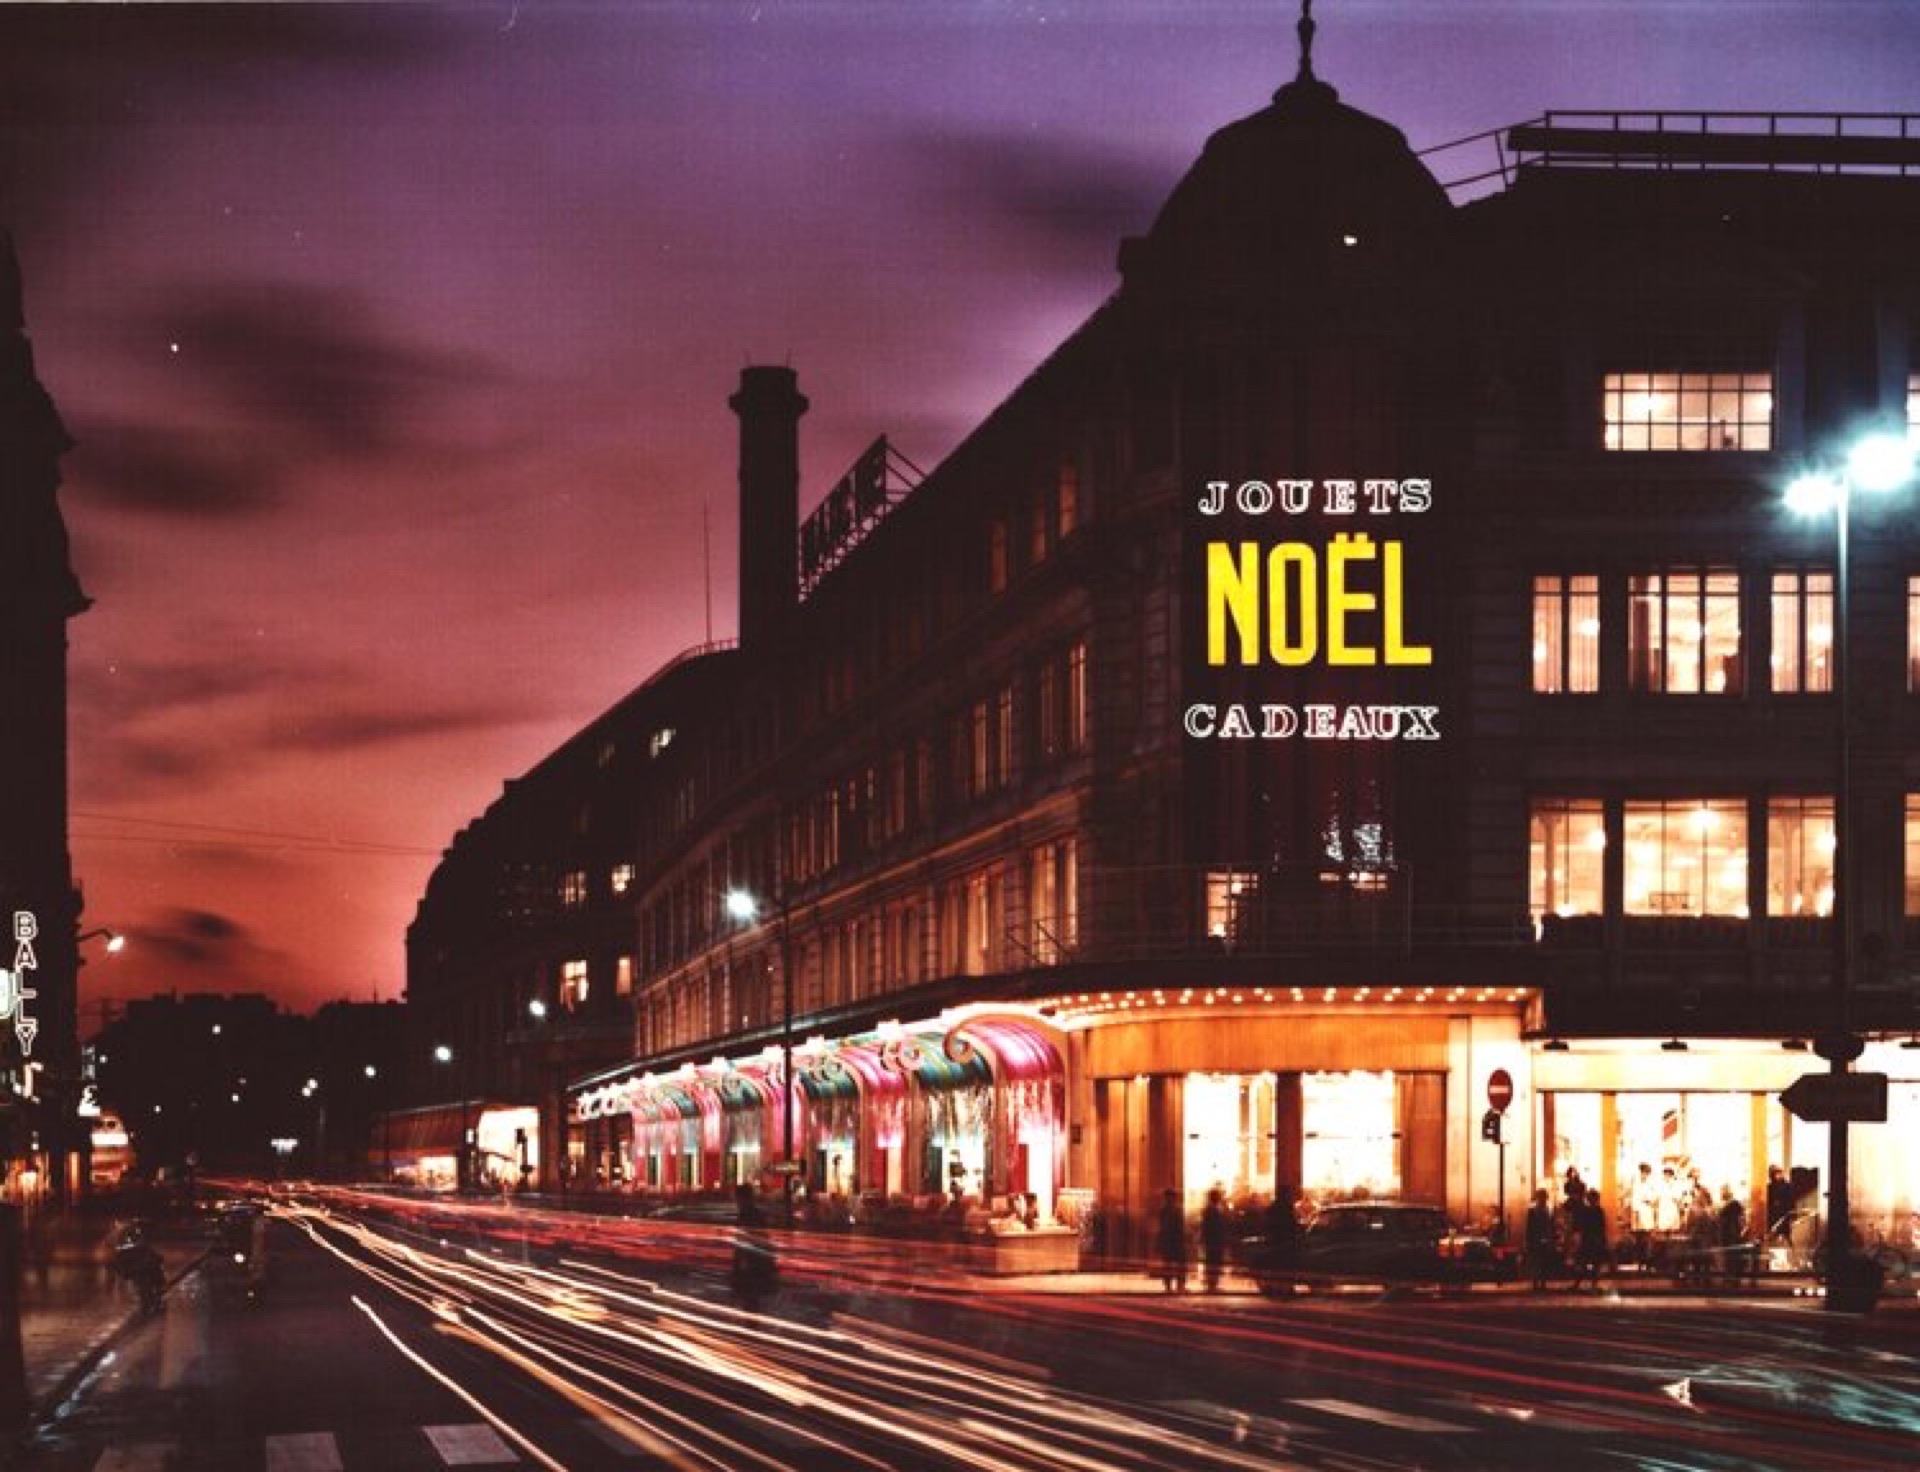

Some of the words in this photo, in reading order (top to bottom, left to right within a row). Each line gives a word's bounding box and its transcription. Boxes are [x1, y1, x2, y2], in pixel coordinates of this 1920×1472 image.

[1198, 478, 1432, 515] JOUETS
[1206, 531, 1433, 667] NOËL
[1184, 703, 1441, 741] CADEAUX
[13, 911, 38, 1057] BALLY
